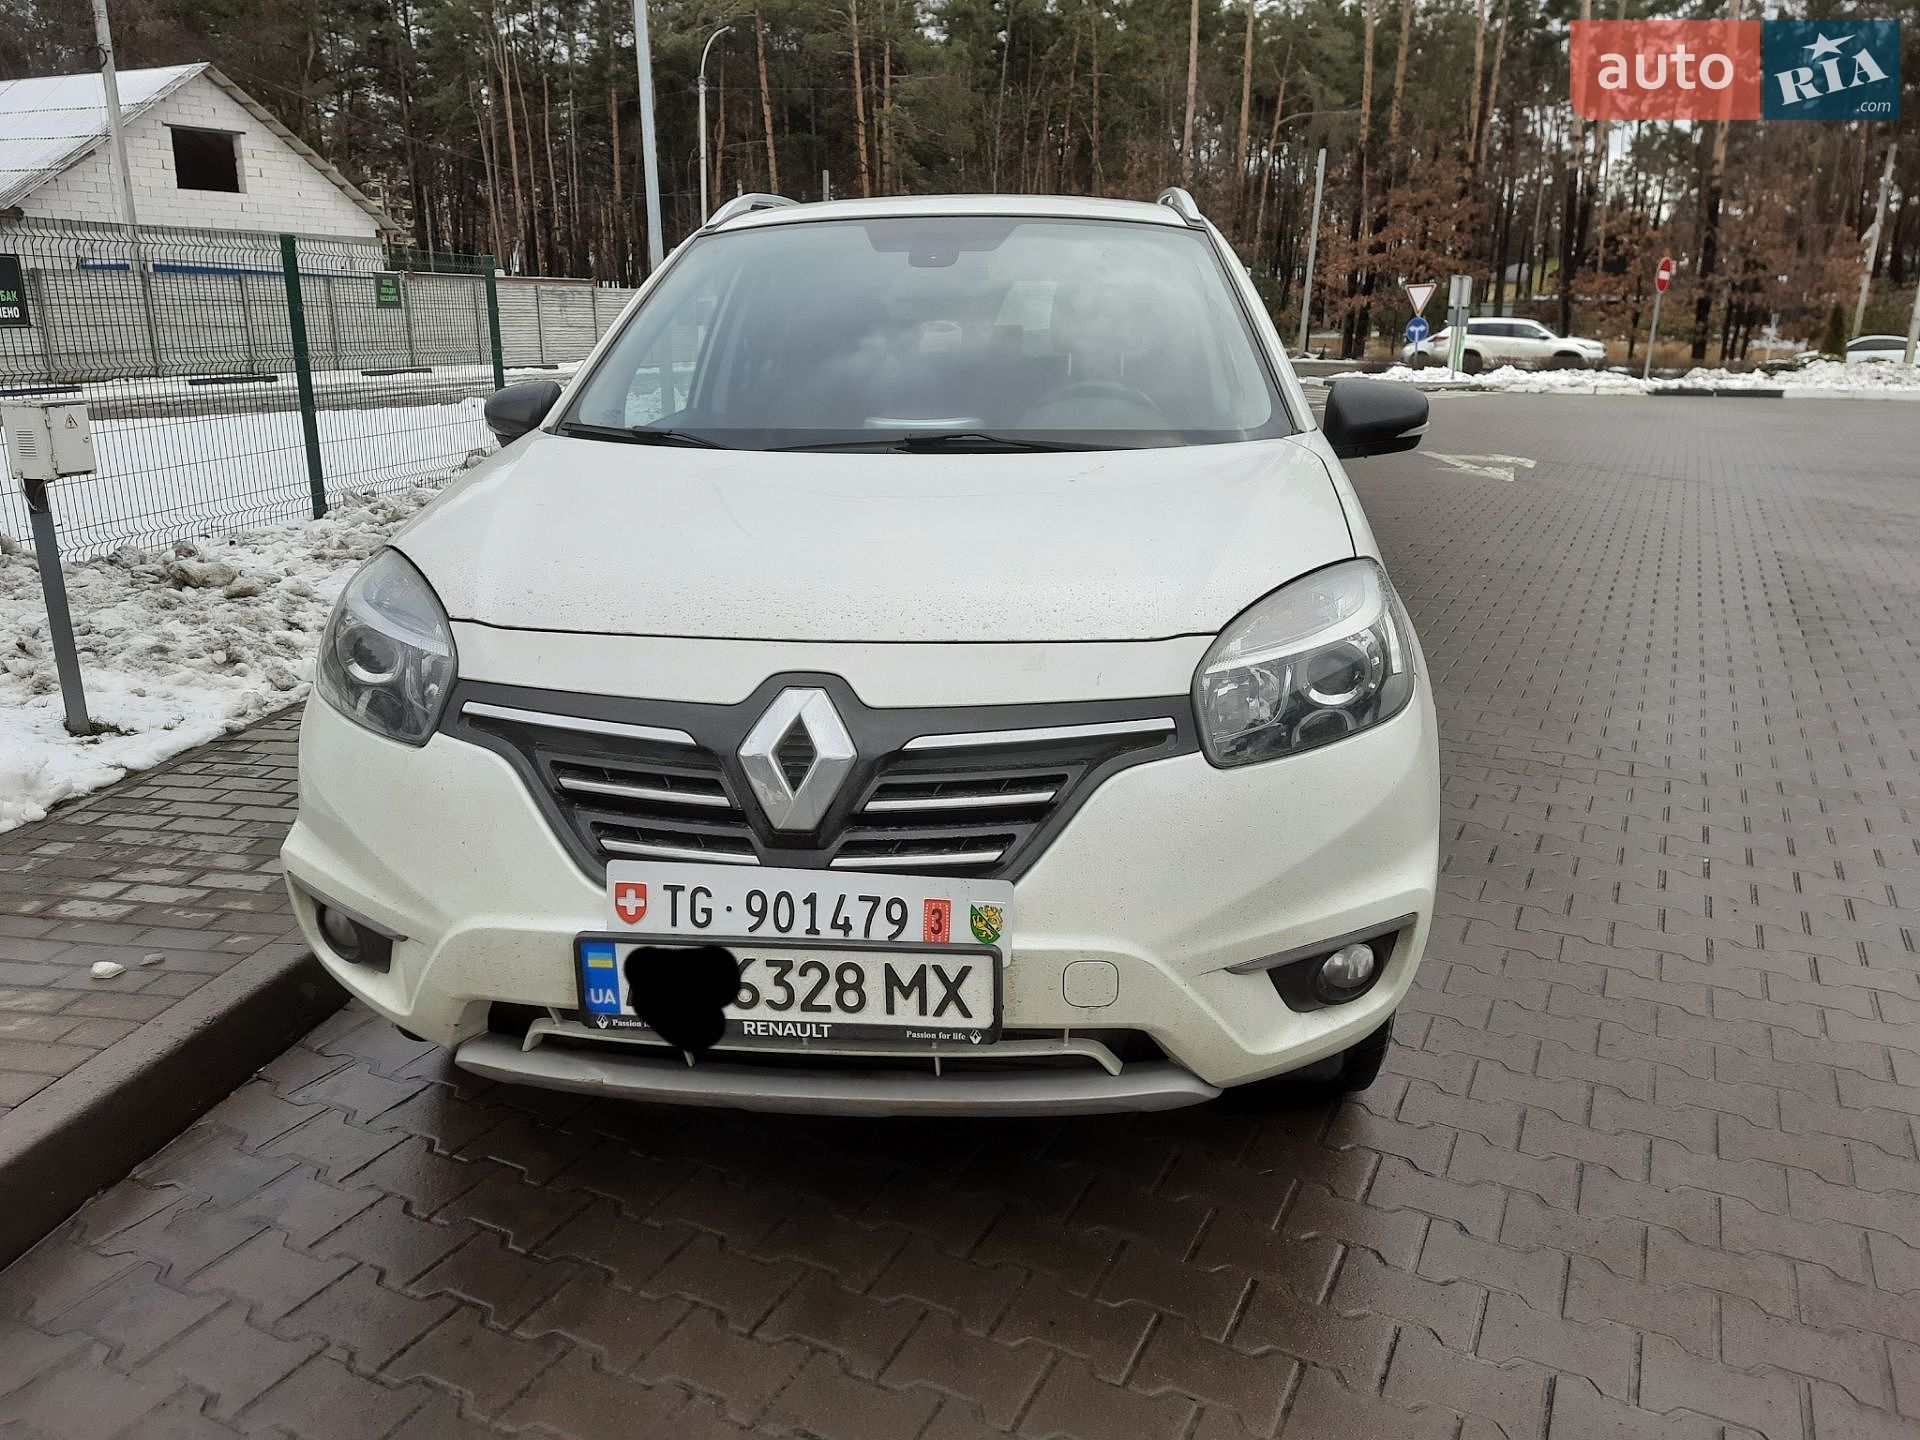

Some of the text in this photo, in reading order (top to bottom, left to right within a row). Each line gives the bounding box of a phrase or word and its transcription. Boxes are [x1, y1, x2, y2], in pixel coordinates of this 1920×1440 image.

[930, 908, 943, 935] 3
[590, 988, 616, 1005] UA
[884, 962, 973, 1019] MX
[612, 1018, 642, 1028] Passion
[743, 1021, 832, 1038] RENAULT
[906, 1030, 966, 1040] Passion for life
